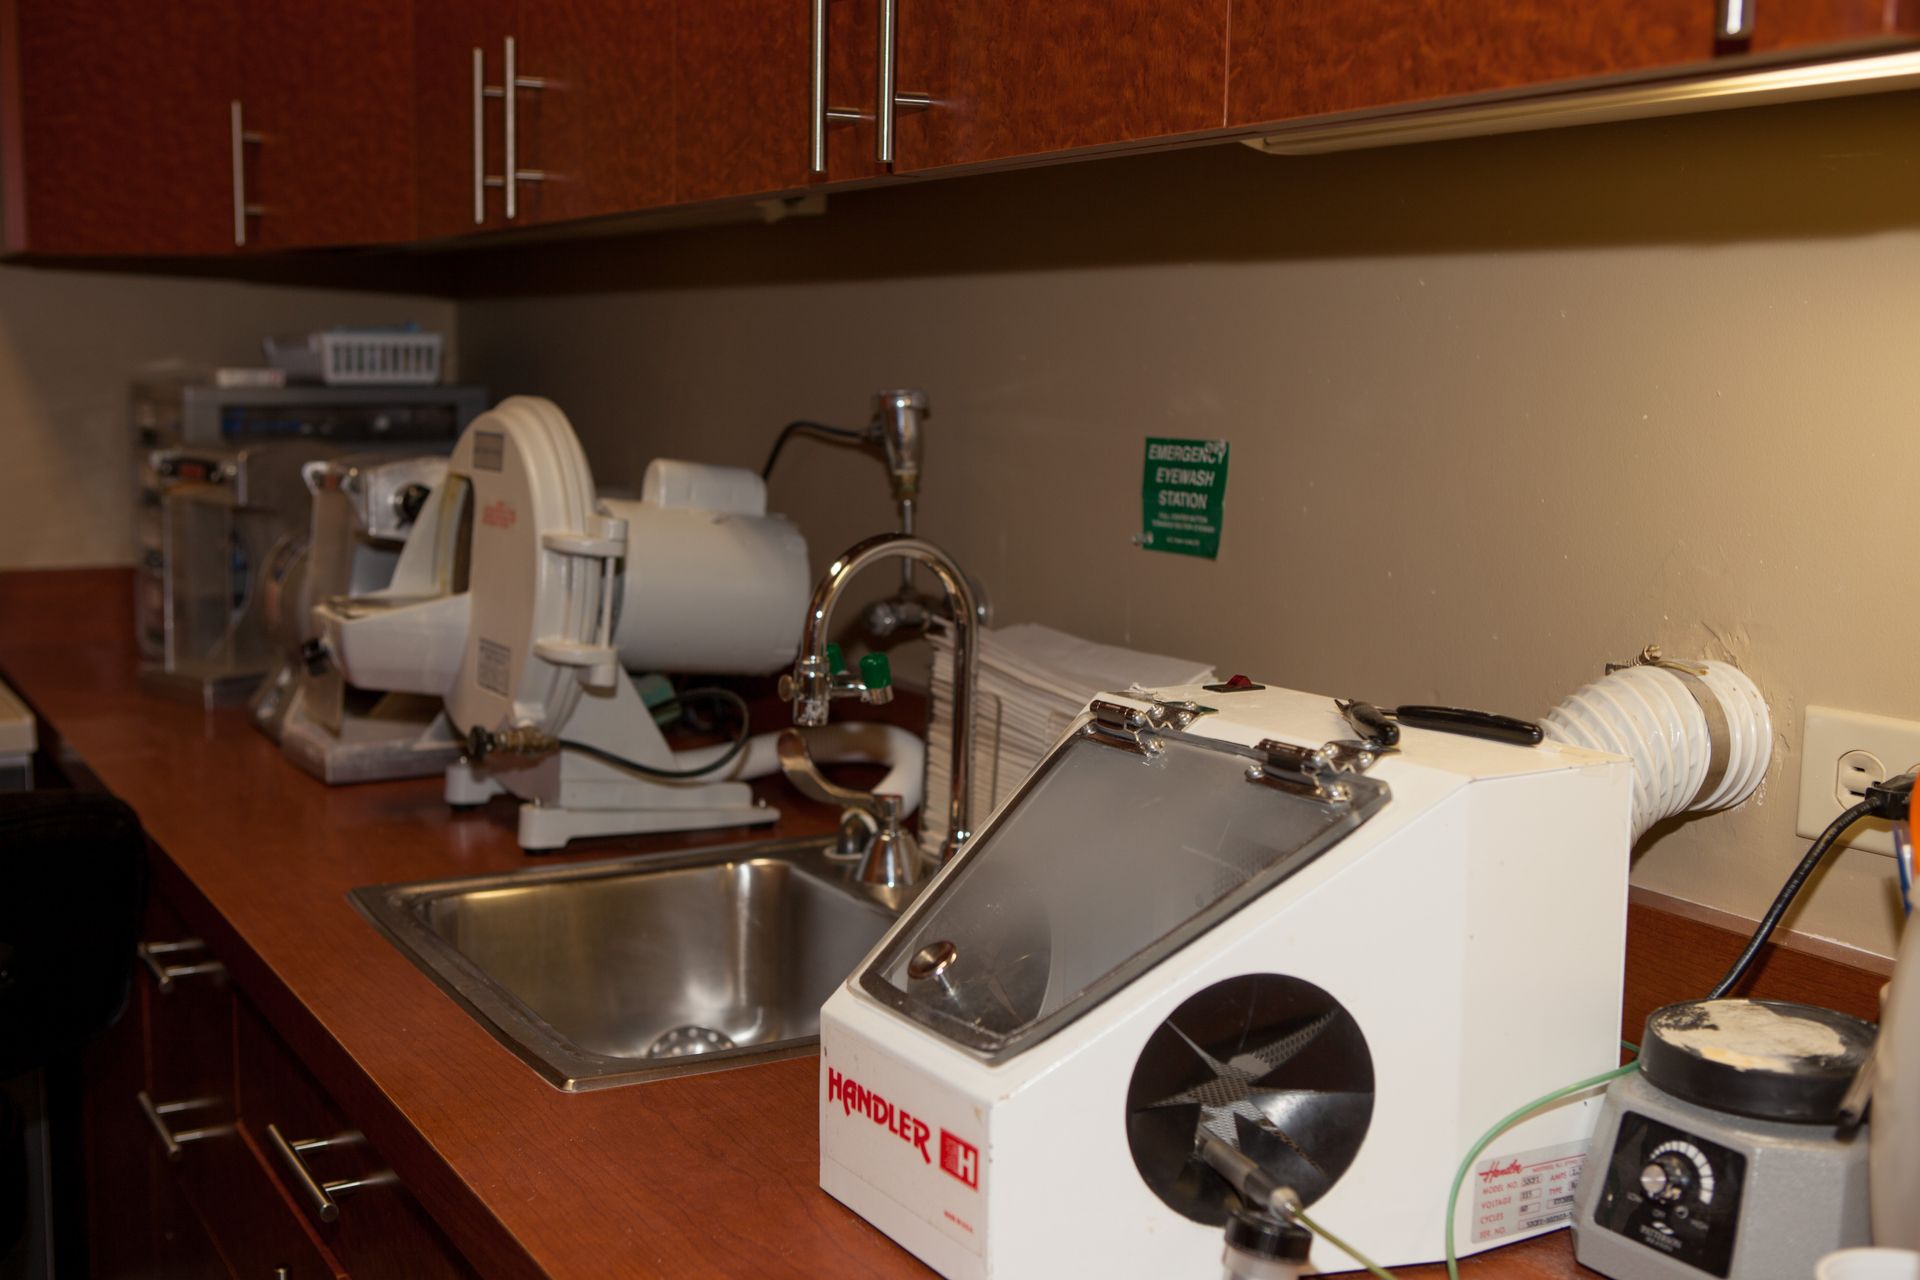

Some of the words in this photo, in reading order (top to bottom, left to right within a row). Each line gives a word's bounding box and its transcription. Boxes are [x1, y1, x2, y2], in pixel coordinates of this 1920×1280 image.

[1148, 443, 1226, 464] EMERGENCY
[1156, 467, 1215, 486] EYEWASH
[1158, 490, 1208, 509] STATION
[828, 1066, 932, 1165] HANDLER
[1483, 1185, 1504, 1194] MODEL
[1481, 1197, 1511, 1209] VOLTAGE
[1480, 1212, 1504, 1224] CYCLES
